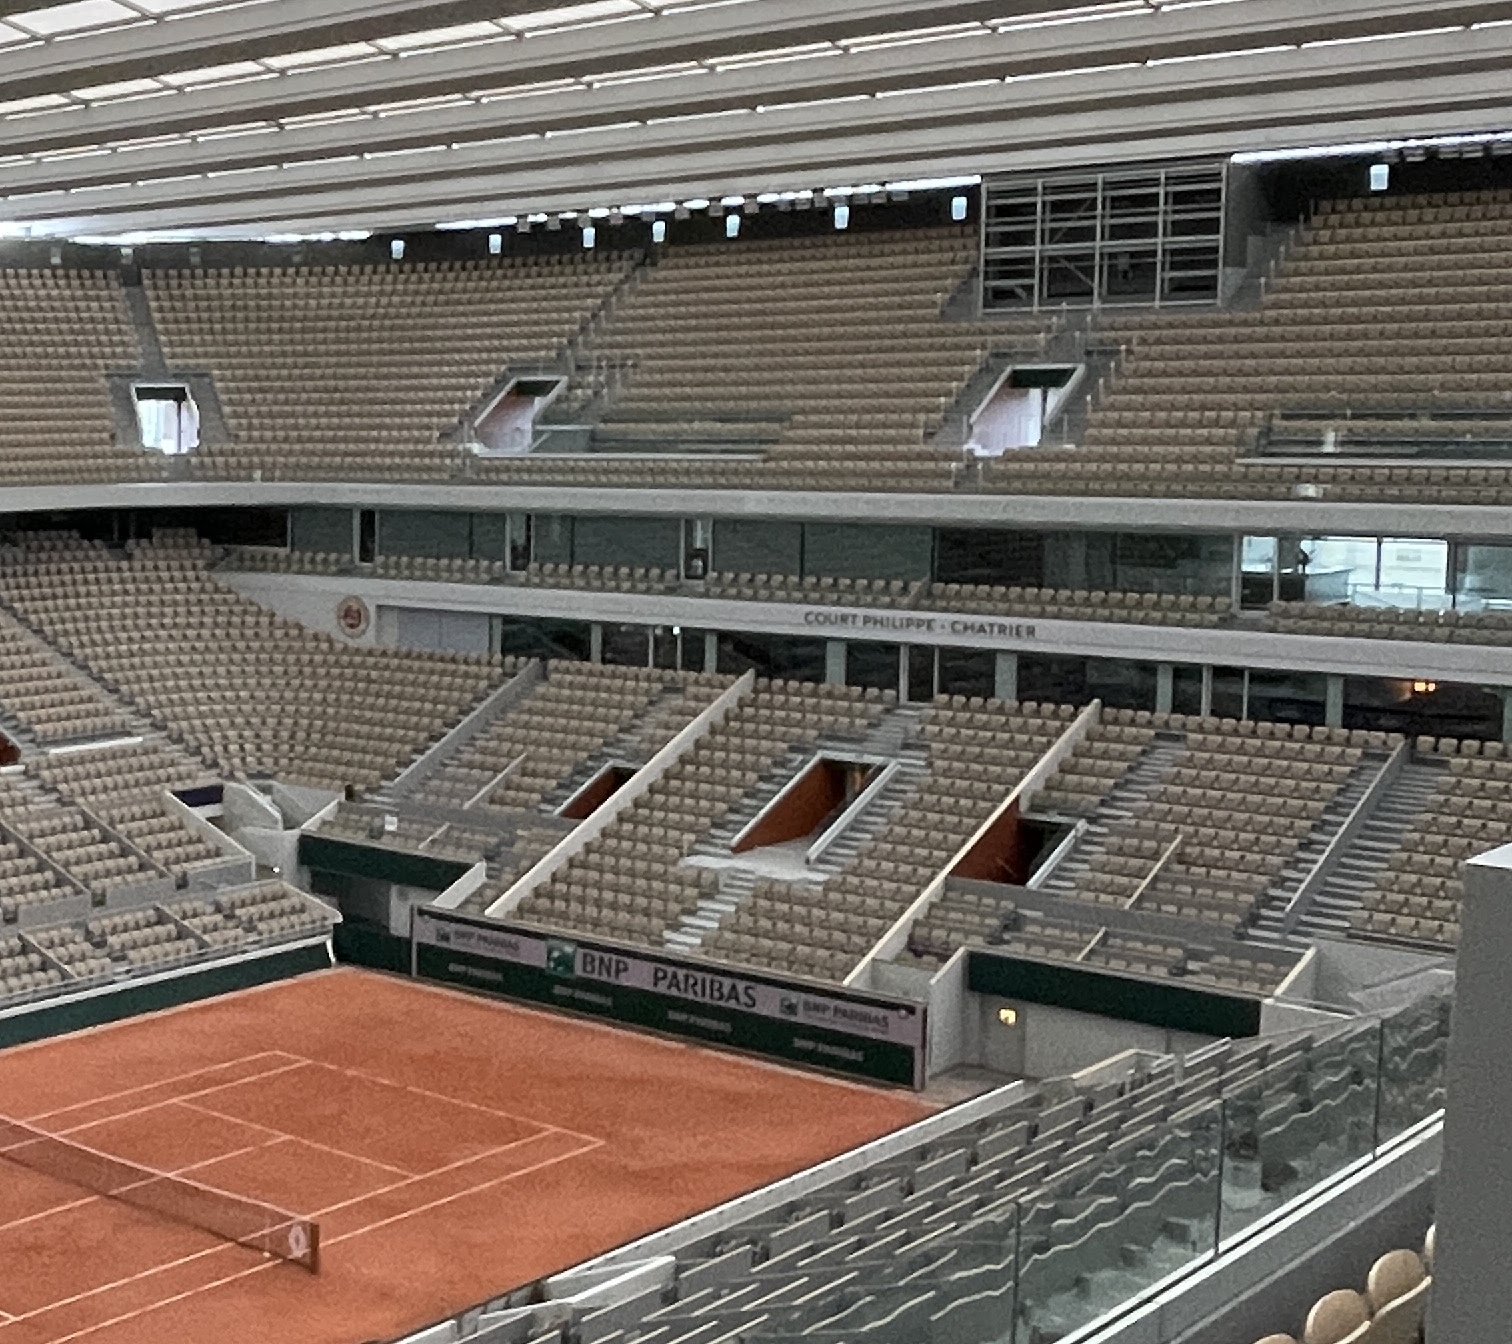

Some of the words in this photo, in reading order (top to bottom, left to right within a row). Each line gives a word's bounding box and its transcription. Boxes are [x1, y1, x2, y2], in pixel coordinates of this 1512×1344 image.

[804, 610, 858, 626] COURT
[862, 614, 937, 632] PHILIPPE
[950, 620, 1036, 638] CHATRIER
[582, 952, 630, 980] BNP
[652, 966, 757, 1008] PARIBAS
